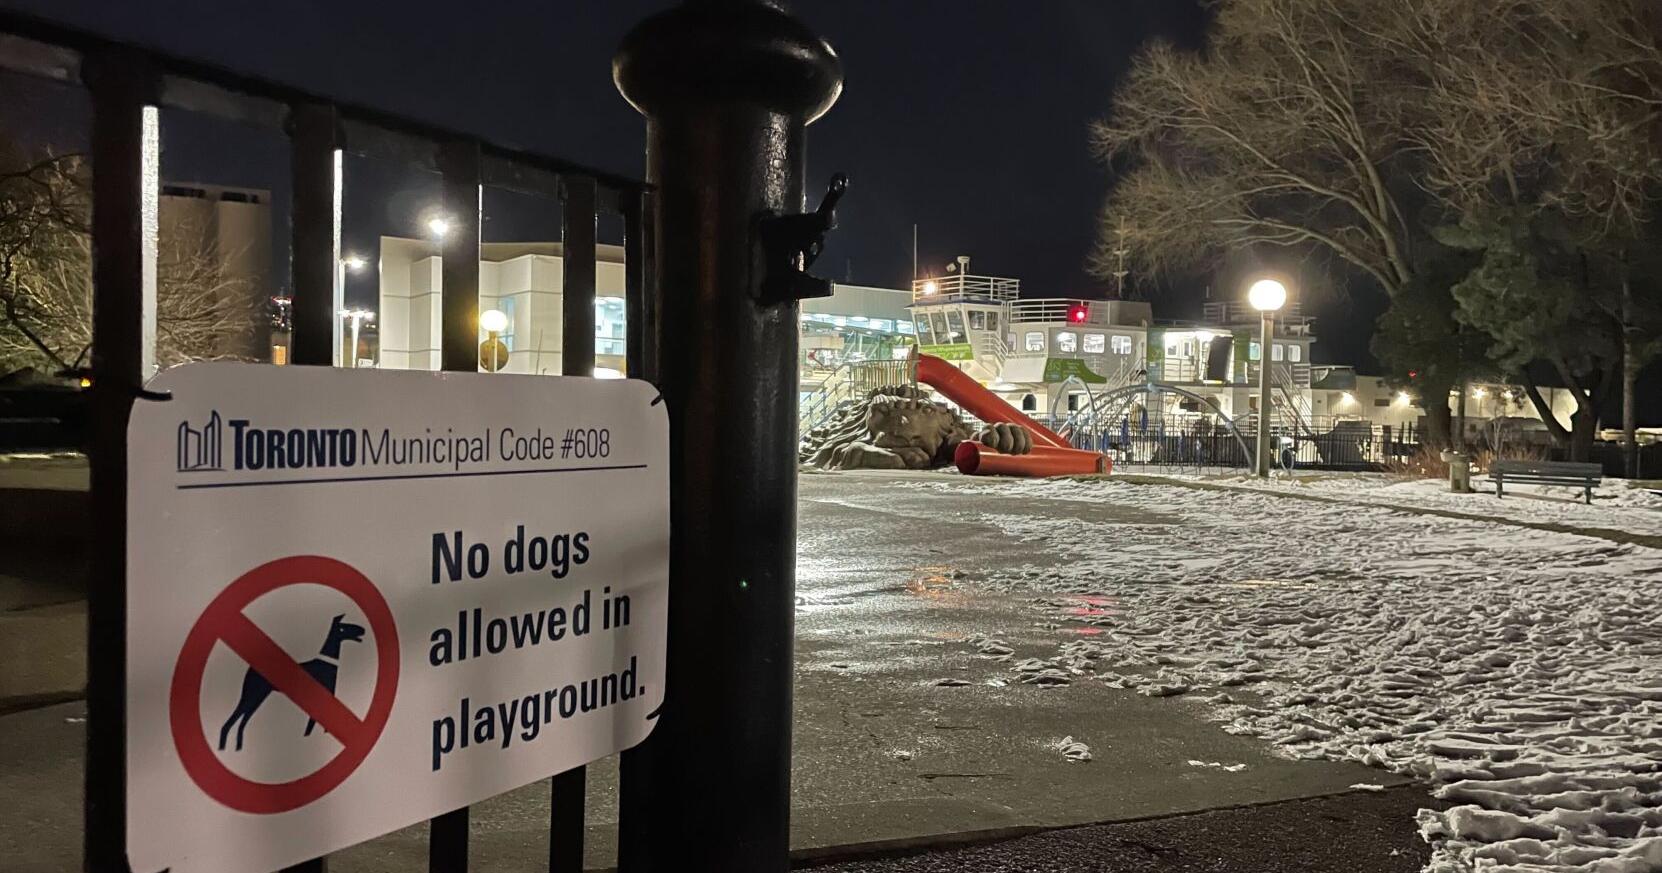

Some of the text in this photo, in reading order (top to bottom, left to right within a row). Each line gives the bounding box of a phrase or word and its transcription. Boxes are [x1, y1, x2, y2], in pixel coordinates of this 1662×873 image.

[228, 419, 611, 472] TORONTO Municipal Code #608
[431, 525, 590, 584] No dogs
[429, 586, 632, 667] allowed in
[431, 655, 646, 773] playground.
